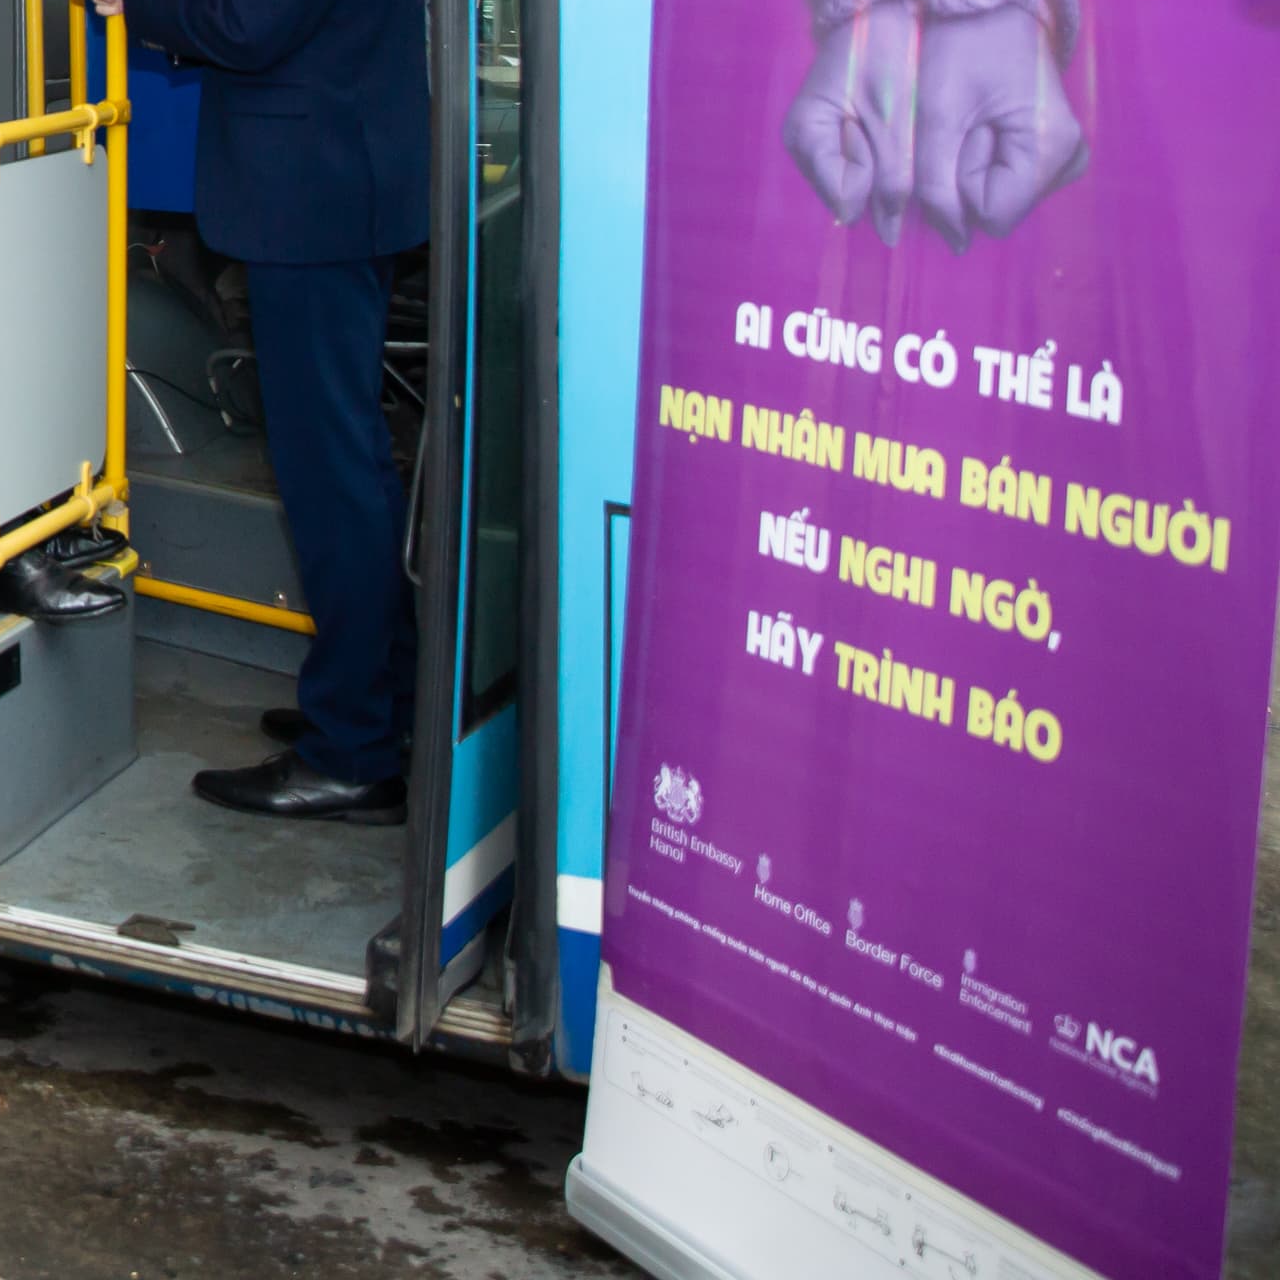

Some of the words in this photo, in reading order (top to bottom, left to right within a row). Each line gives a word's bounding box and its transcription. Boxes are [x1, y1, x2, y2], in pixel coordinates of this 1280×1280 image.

[736, 302, 772, 349] AI
[783, 308, 882, 373] CŨNG
[894, 330, 957, 388] CÓ
[973, 339, 1058, 410] THỂ
[1066, 360, 1123, 425] LÀ
[659, 385, 732, 443] NẠN
[742, 404, 845, 471] NHÂN
[853, 432, 946, 499] MUA
[960, 455, 1052, 526] BÁN
[1065, 482, 1230, 573] NGƯỜI
[759, 508, 829, 573] NẾU
[839, 536, 936, 608] NGHI
[950, 568, 1061, 652] NGỜ,
[746, 611, 823, 676] HÃY
[835, 642, 955, 725] TRÌNH
[967, 689, 1063, 763] BÁO
[649, 834, 684, 862] Hanoi
[651, 817, 688, 846] British
[690, 835, 742, 874] Embassy
[754, 883, 791, 915] Home
[794, 903, 831, 935] Office
[845, 930, 897, 965] Border
[900, 954, 943, 989] Force
[1085, 1021, 1159, 1085] NCA
